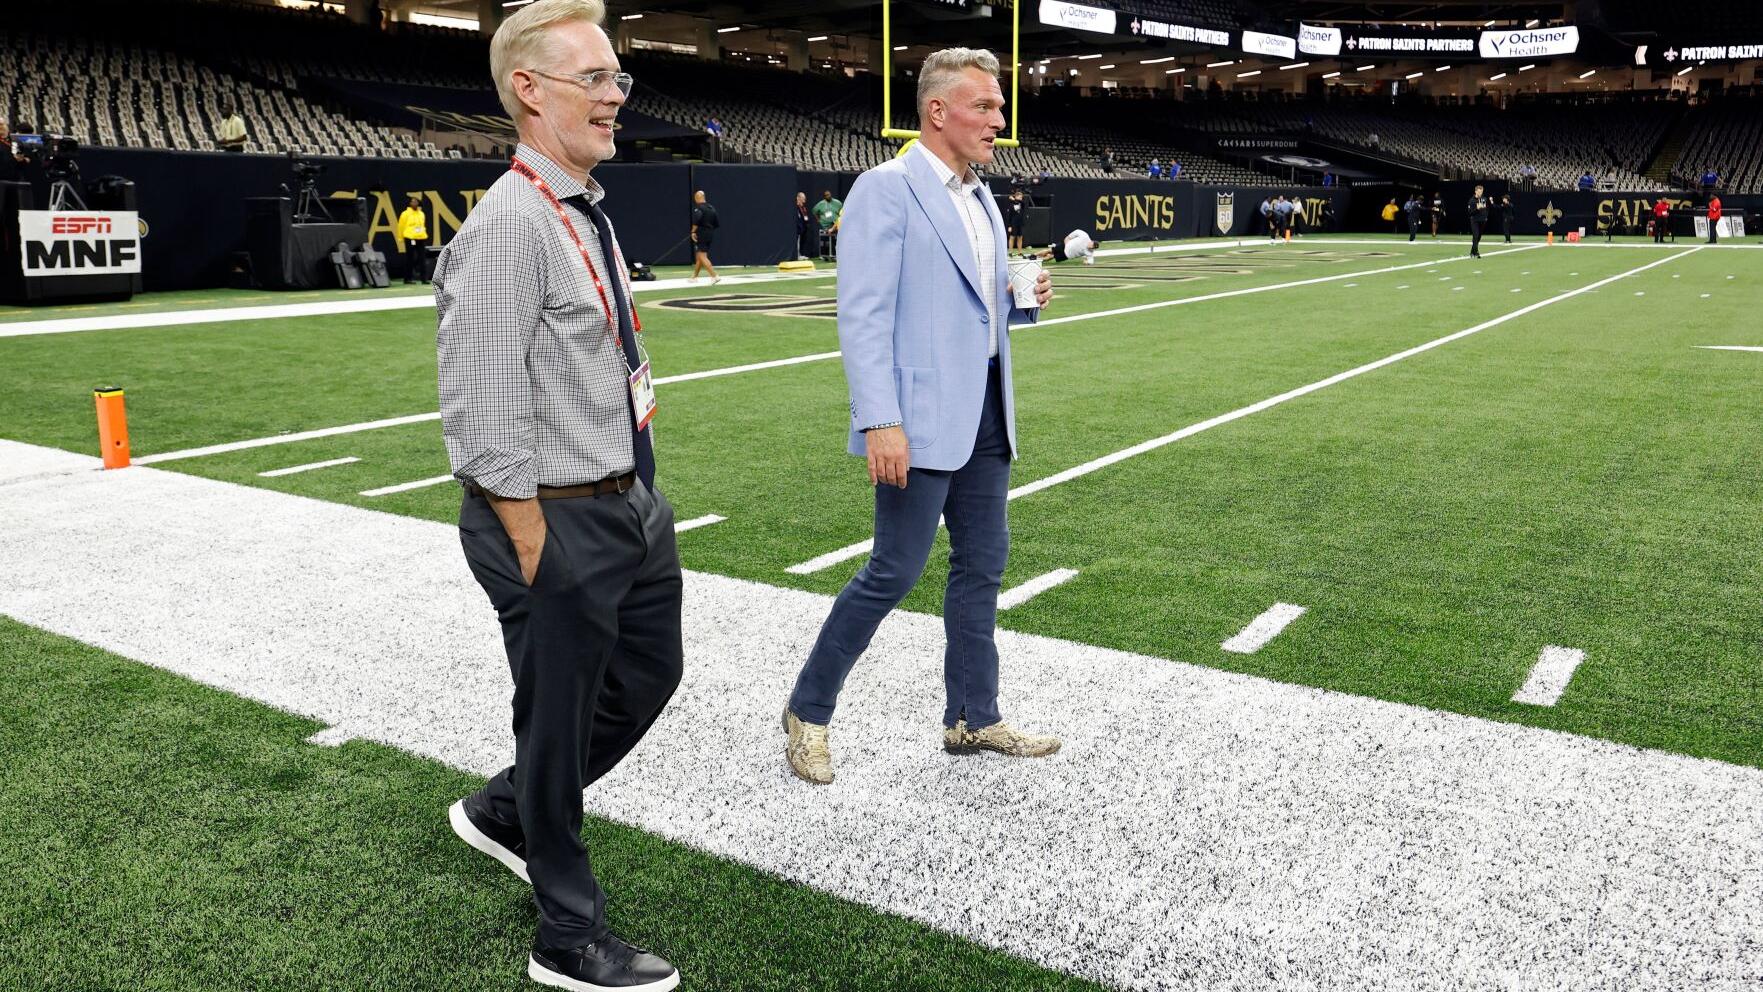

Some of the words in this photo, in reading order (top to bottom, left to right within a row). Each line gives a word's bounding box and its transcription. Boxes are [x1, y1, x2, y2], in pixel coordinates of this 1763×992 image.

[1069, 6, 1098, 20] Ochsner
[1141, 20, 1169, 38] PATRON
[1169, 24, 1194, 41] SAINTS
[1195, 28, 1230, 46] PARTNERS
[1509, 32, 1567, 44] Ochsner
[1358, 37, 1392, 50] PATRON
[1392, 38, 1426, 51] SAINTS
[1426, 39, 1474, 51] PARTNERS
[1509, 45, 1548, 56] Health
[1681, 46, 1727, 60] PATRON
[1218, 139, 1256, 147] CAESARS
[1256, 140, 1298, 148] SUPERDOME
[1096, 194, 1174, 231] SAINTS
[52, 217, 111, 234] ESPN
[26, 239, 136, 269] MNF
